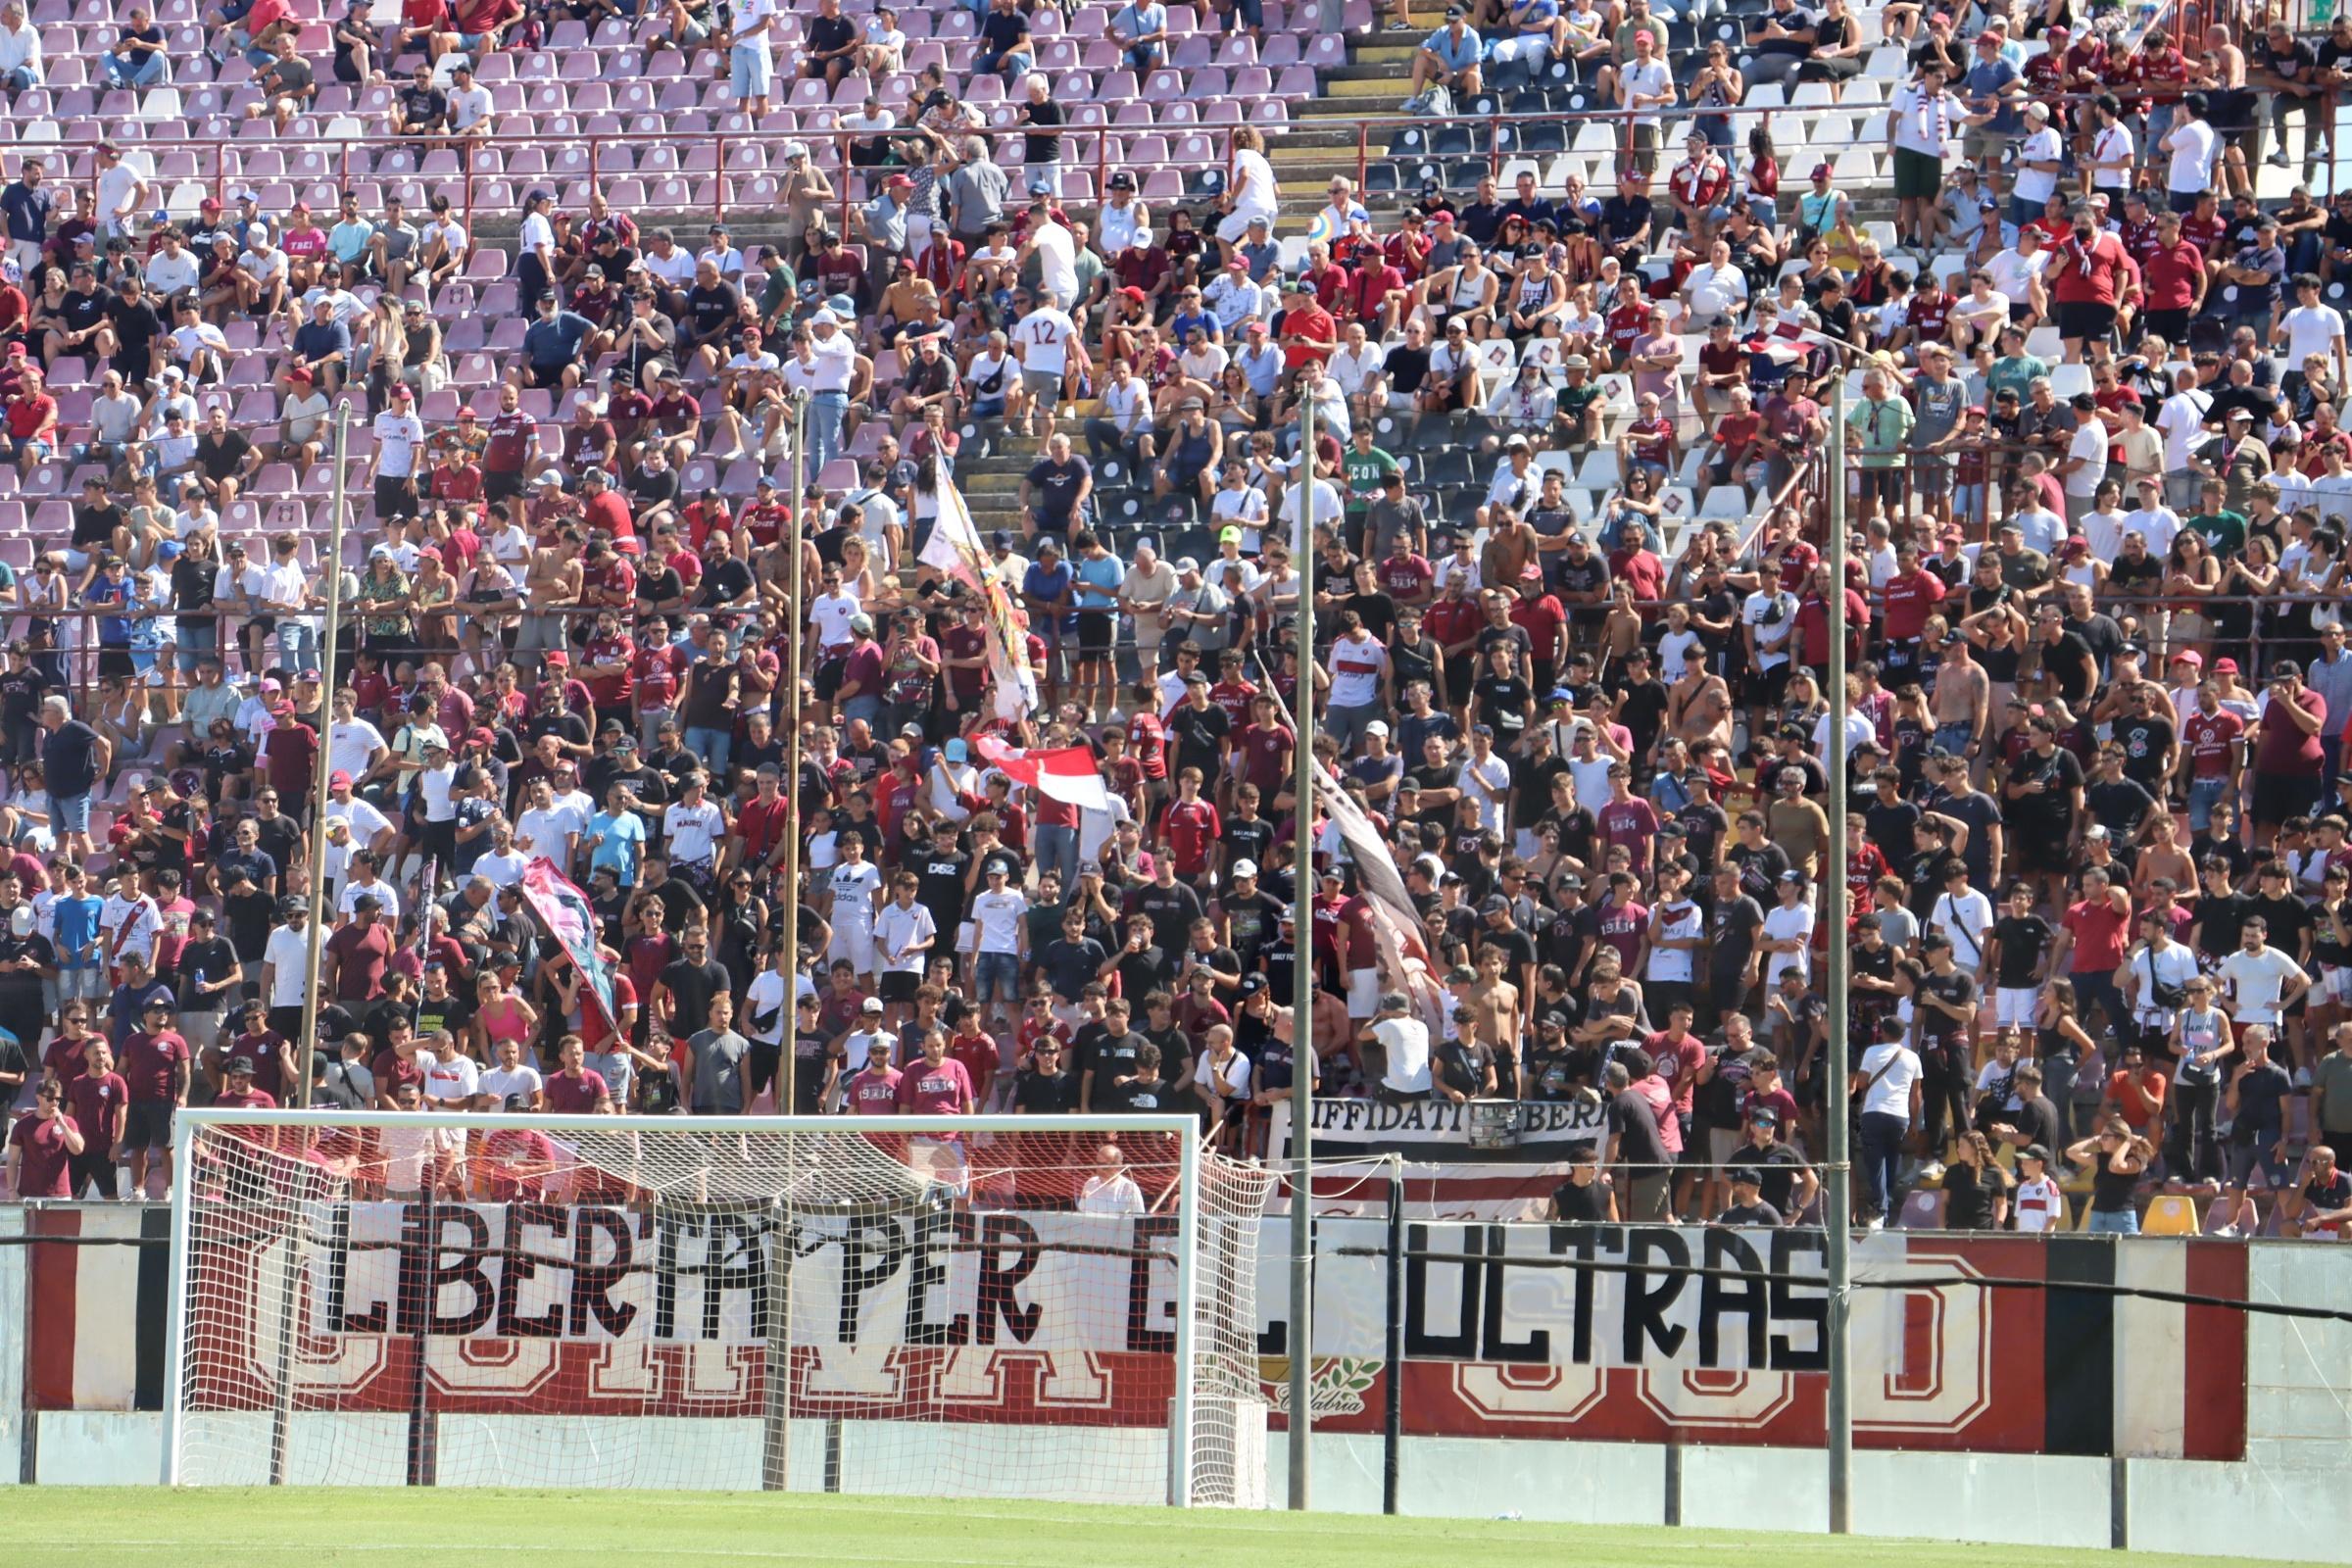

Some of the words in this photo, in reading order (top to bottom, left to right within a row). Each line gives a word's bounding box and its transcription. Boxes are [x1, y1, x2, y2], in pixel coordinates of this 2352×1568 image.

[1032, 319, 1057, 344] 12
[1351, 466, 1380, 479] CON
[676, 818, 702, 827] MAURO
[927, 861, 956, 875] DS2
[1288, 1100, 1462, 1132] IFFIDATI
[836, 1212, 1045, 1347] PER
[1404, 1223, 1831, 1373] ULTRAS
[1277, 1384, 1363, 1413] Clabria
